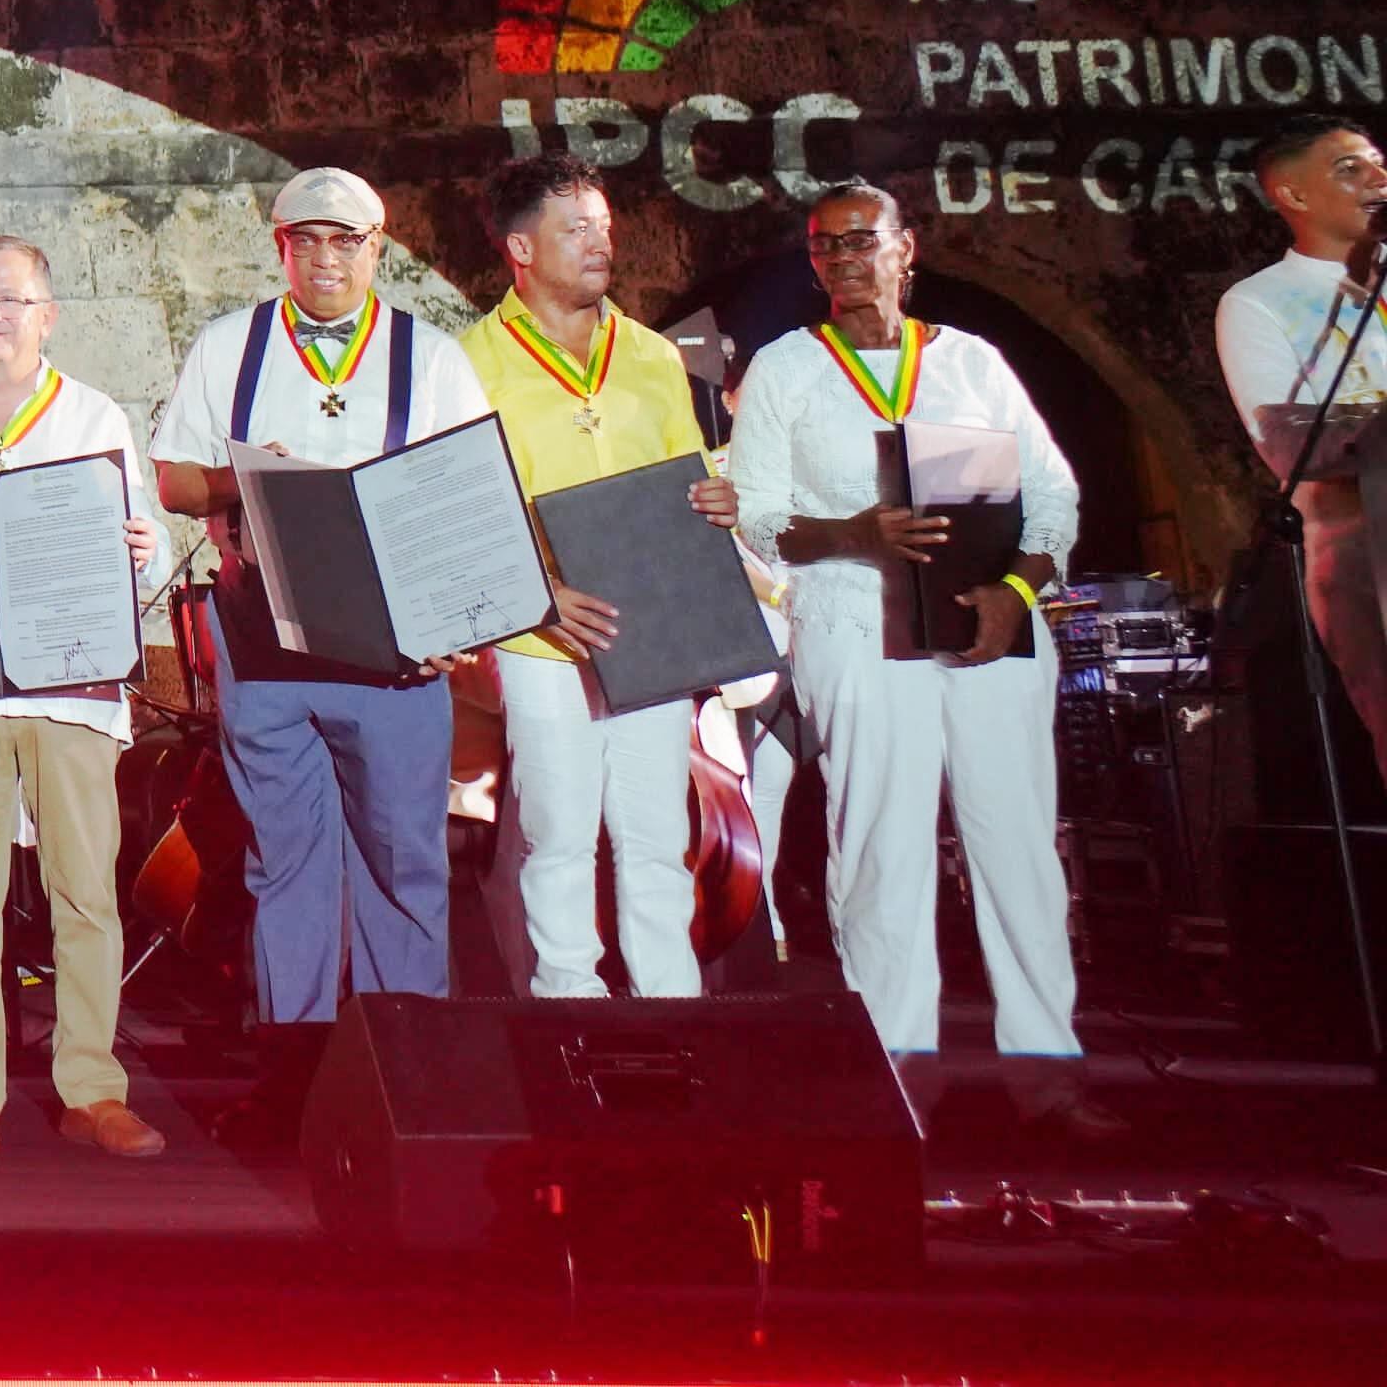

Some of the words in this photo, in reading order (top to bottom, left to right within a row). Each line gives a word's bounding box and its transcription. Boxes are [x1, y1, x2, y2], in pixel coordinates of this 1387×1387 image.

[914, 33, 1385, 109] PATRIMON
[500, 92, 863, 212] IPCC
[933, 139, 1057, 215] DE
